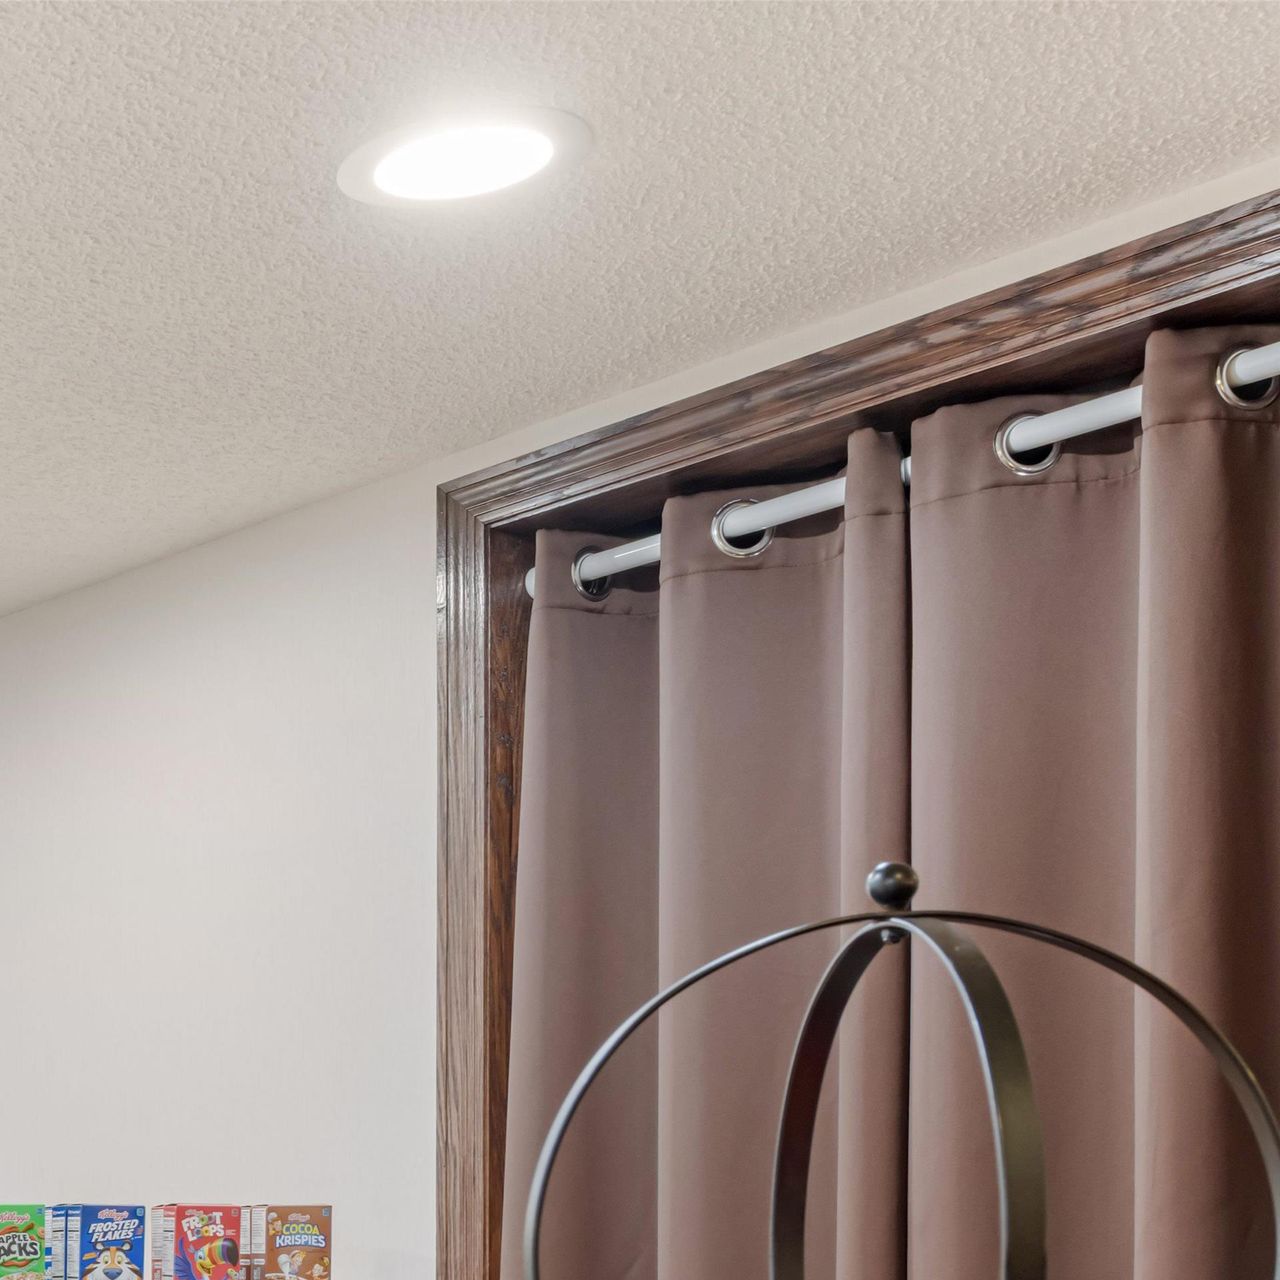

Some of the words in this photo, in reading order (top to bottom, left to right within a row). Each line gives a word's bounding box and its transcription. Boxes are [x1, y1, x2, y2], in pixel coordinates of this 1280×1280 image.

[88, 1219, 139, 1233] FROSTED
[187, 1224, 224, 1241] LOOPS
[282, 1223, 319, 1235] COCOA
[91, 1228, 134, 1243] FLAKES
[275, 1234, 326, 1248] KRISPIES
